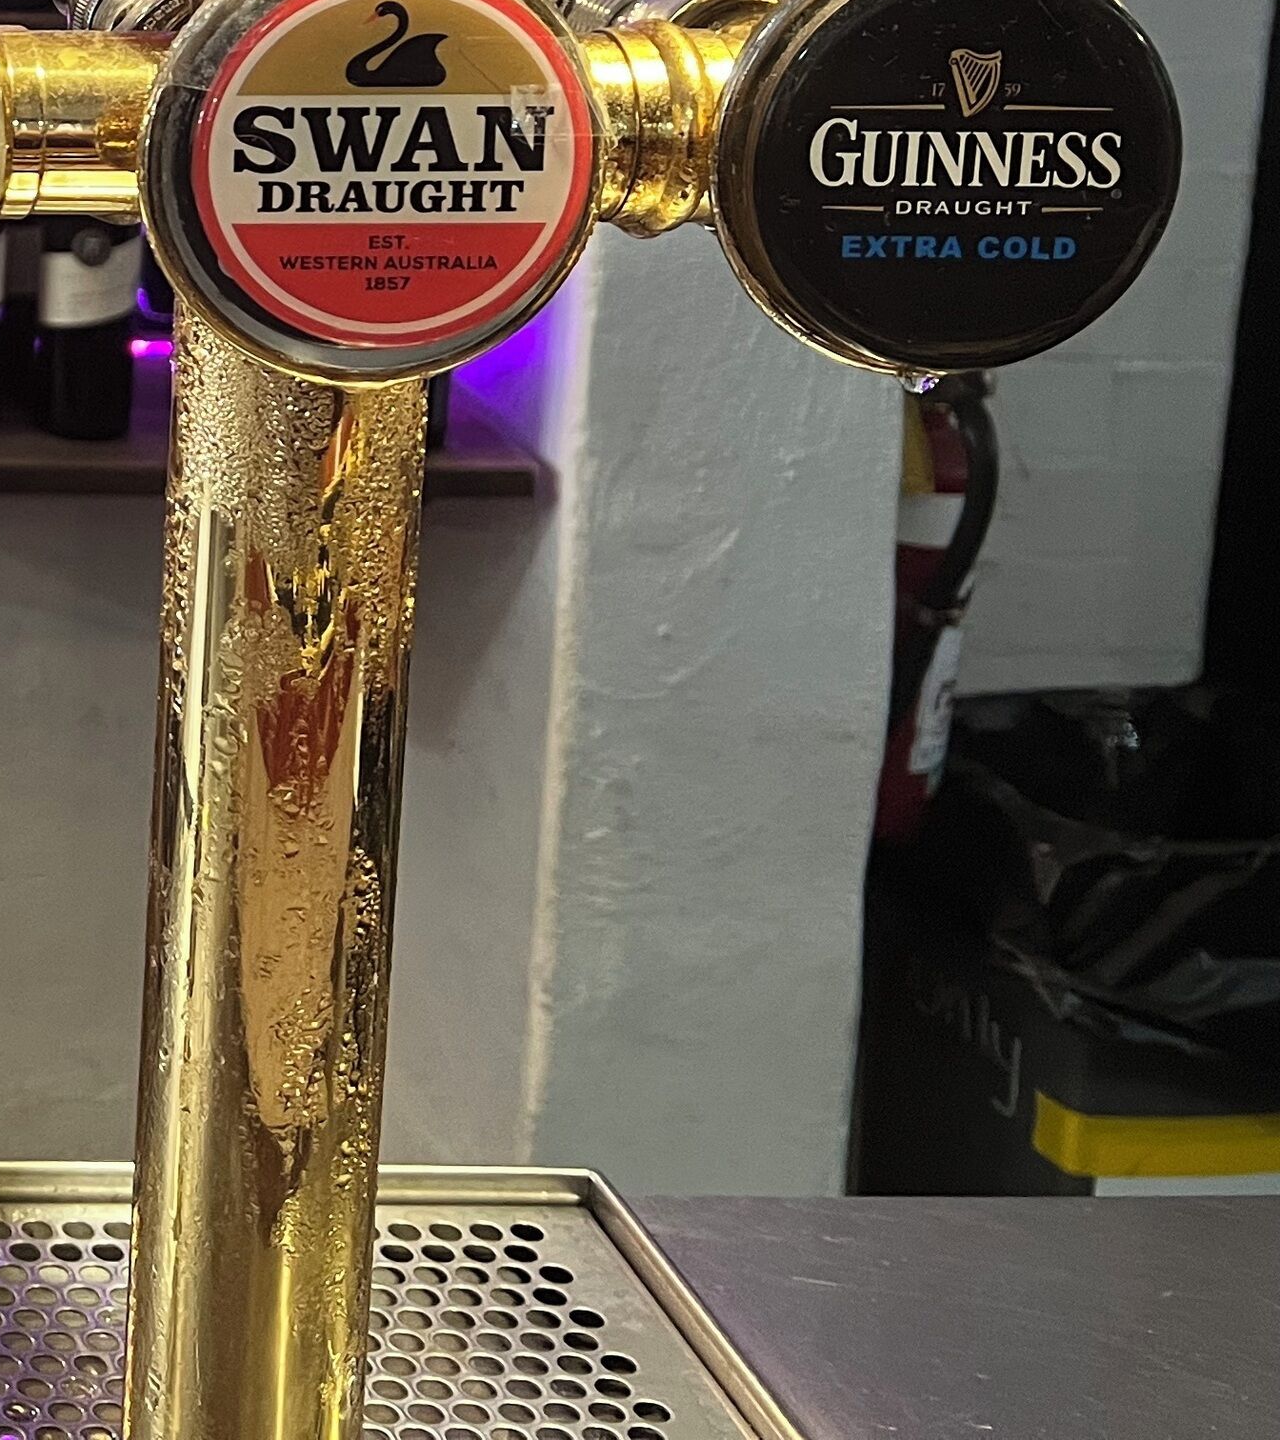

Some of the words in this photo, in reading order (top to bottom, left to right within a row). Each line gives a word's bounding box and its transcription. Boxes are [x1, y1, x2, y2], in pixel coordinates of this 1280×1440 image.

[930, 82, 946, 98] 17
[1003, 83, 1022, 98] 59
[233, 105, 554, 175] SWAN
[257, 179, 525, 214] DRAUGHT
[895, 200, 1033, 216] DRAUGHT
[368, 234, 411, 251] EST.
[841, 235, 963, 259] EXTRA
[977, 235, 1077, 260] COLD
[279, 255, 378, 271] WESTERN
[383, 254, 498, 271] AUSTRALIA
[365, 276, 411, 291] 1857
